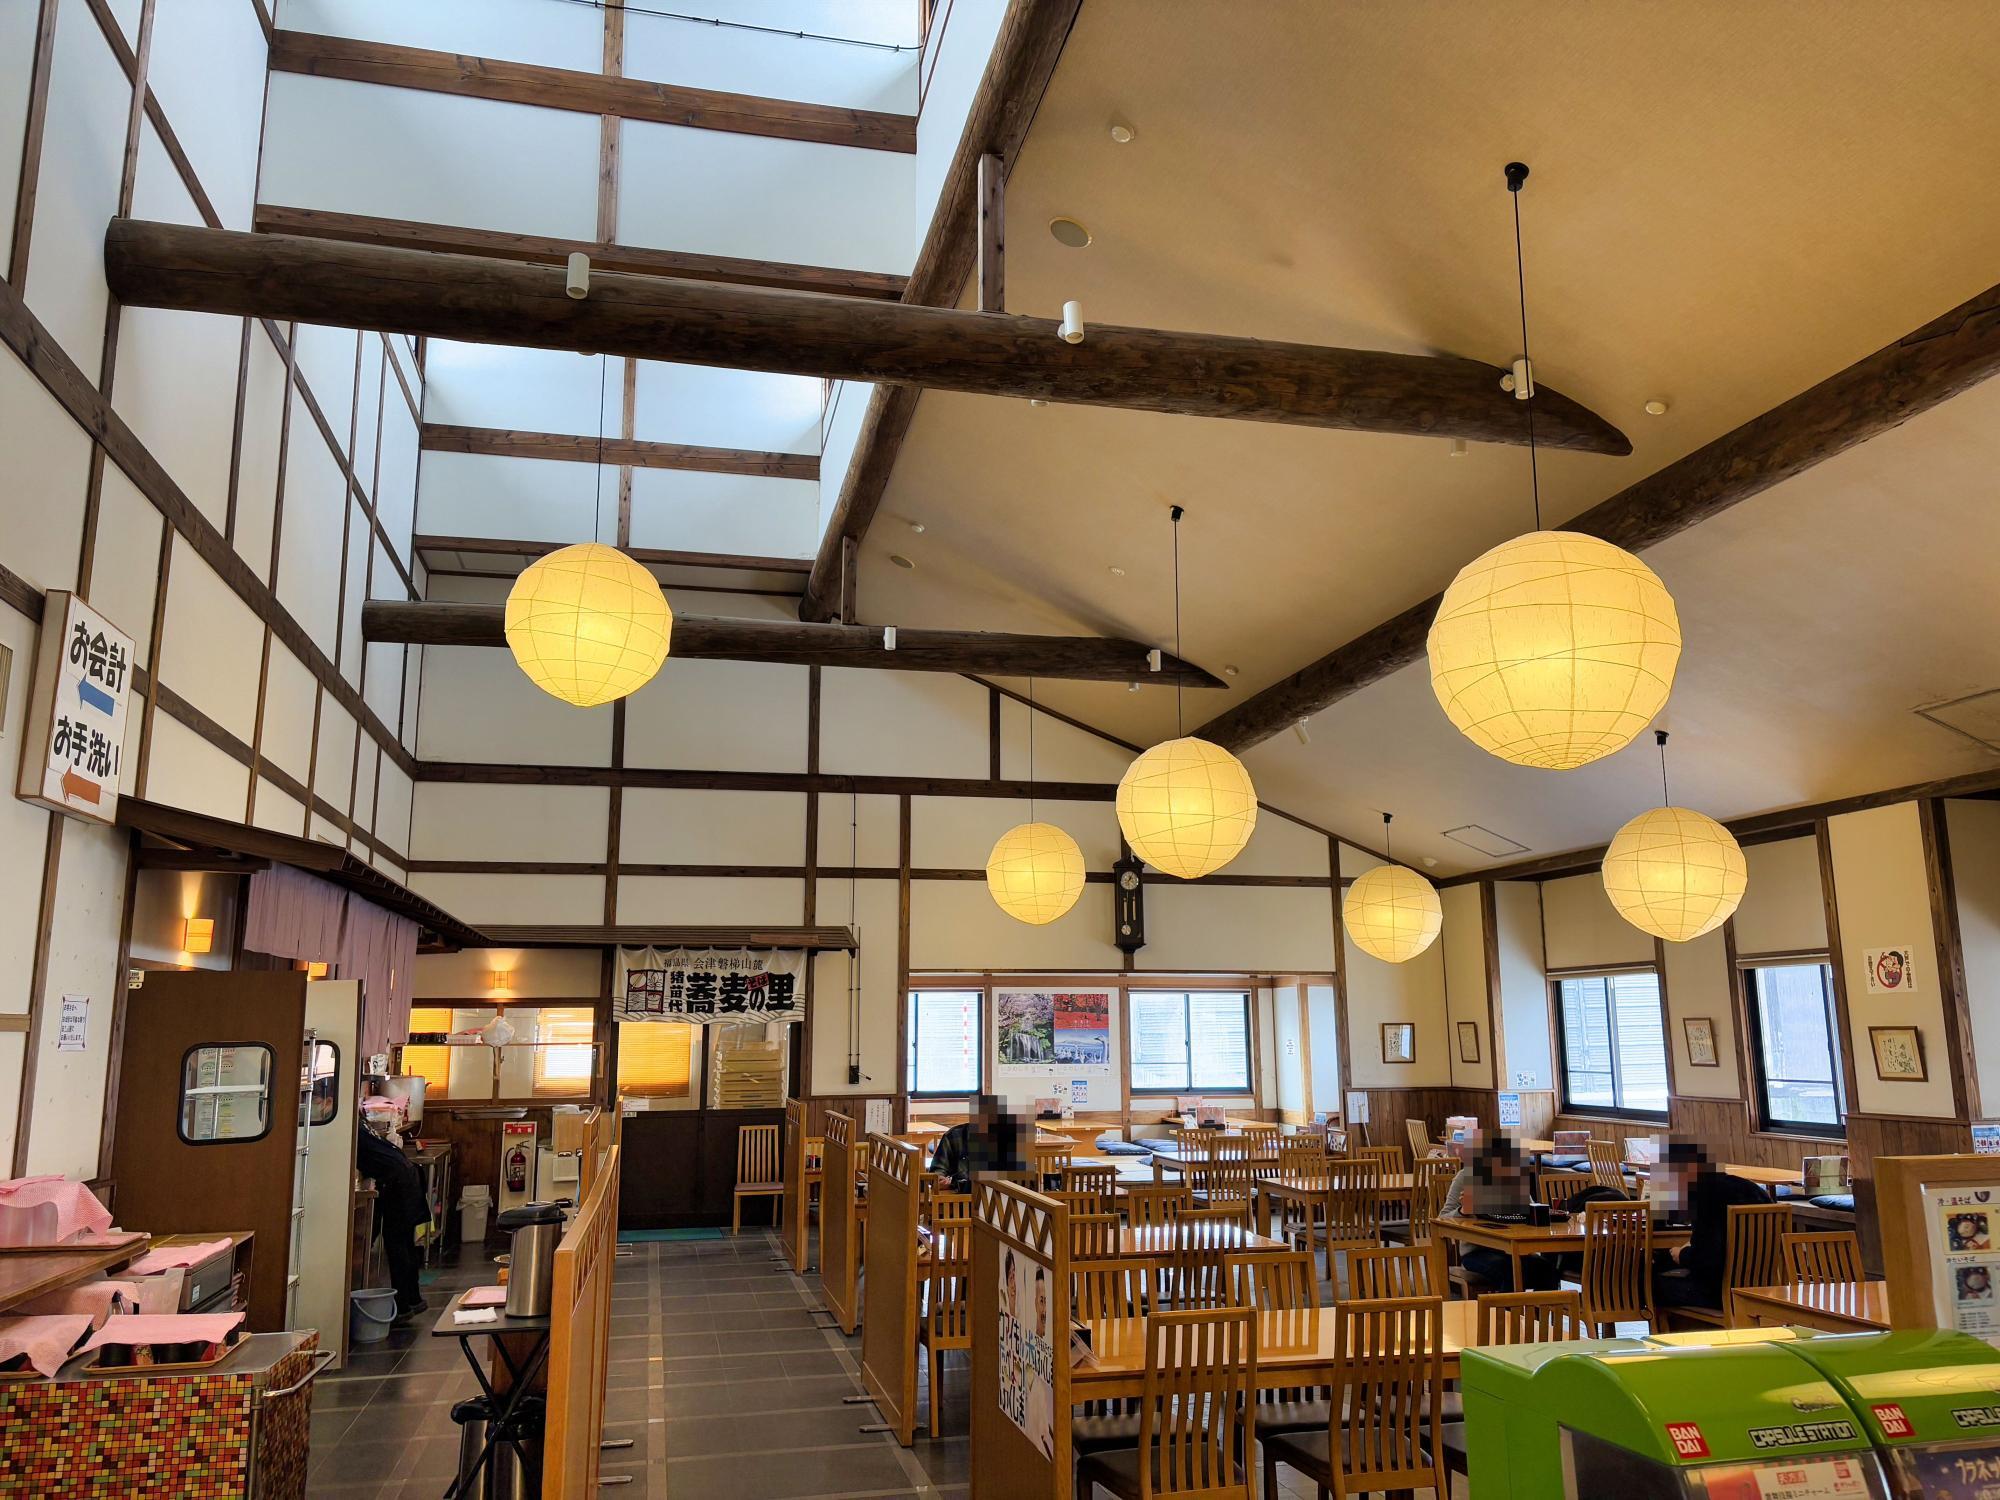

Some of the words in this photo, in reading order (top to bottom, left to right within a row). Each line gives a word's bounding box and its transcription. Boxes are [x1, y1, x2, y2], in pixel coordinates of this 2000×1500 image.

[70, 621, 126, 693] お会計
[53, 715, 120, 778] お手洗い
[668, 970, 685, 1013] 猪苗代
[686, 972, 796, 1013] 蕎麦の里
[1873, 1407, 1905, 1421] BAN
[1881, 1419, 1908, 1434] DAI
[1668, 1425, 1701, 1440] BAN
[1675, 1438, 1702, 1454] DAI
